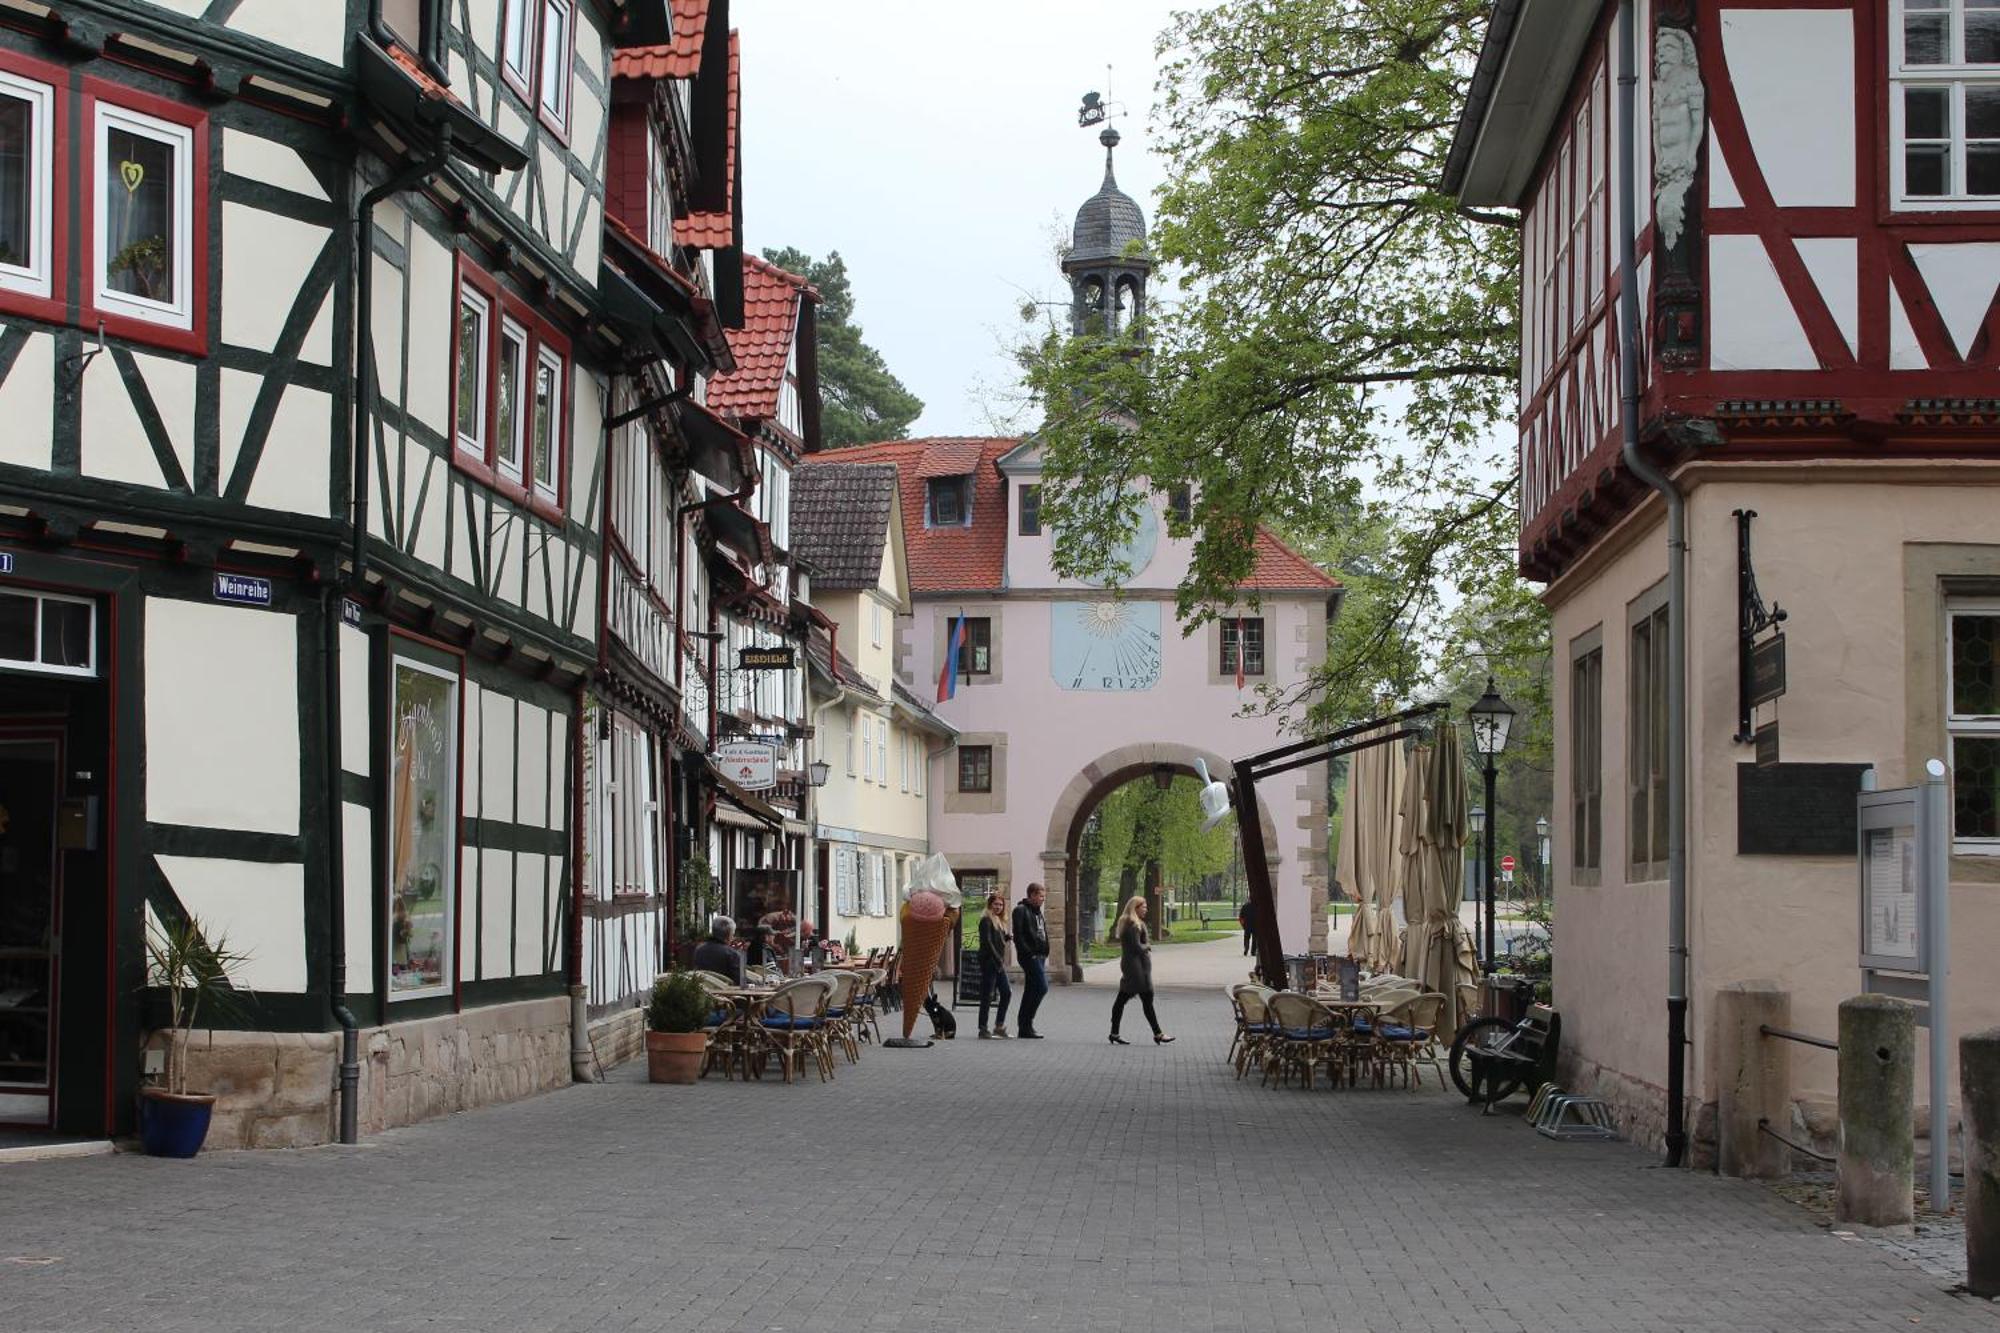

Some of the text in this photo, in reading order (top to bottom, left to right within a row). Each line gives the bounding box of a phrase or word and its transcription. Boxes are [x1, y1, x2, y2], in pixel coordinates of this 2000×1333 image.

[218, 575, 269, 599] Weinreihe
[1150, 631, 1161, 641] 8
[1150, 655, 1160, 669] 6
[1150, 668, 1158, 678] 5
[1102, 677, 1113, 689] 12
[1118, 677, 1124, 689] 1
[1130, 678, 1137, 689] 2
[1138, 677, 1146, 689] 3
